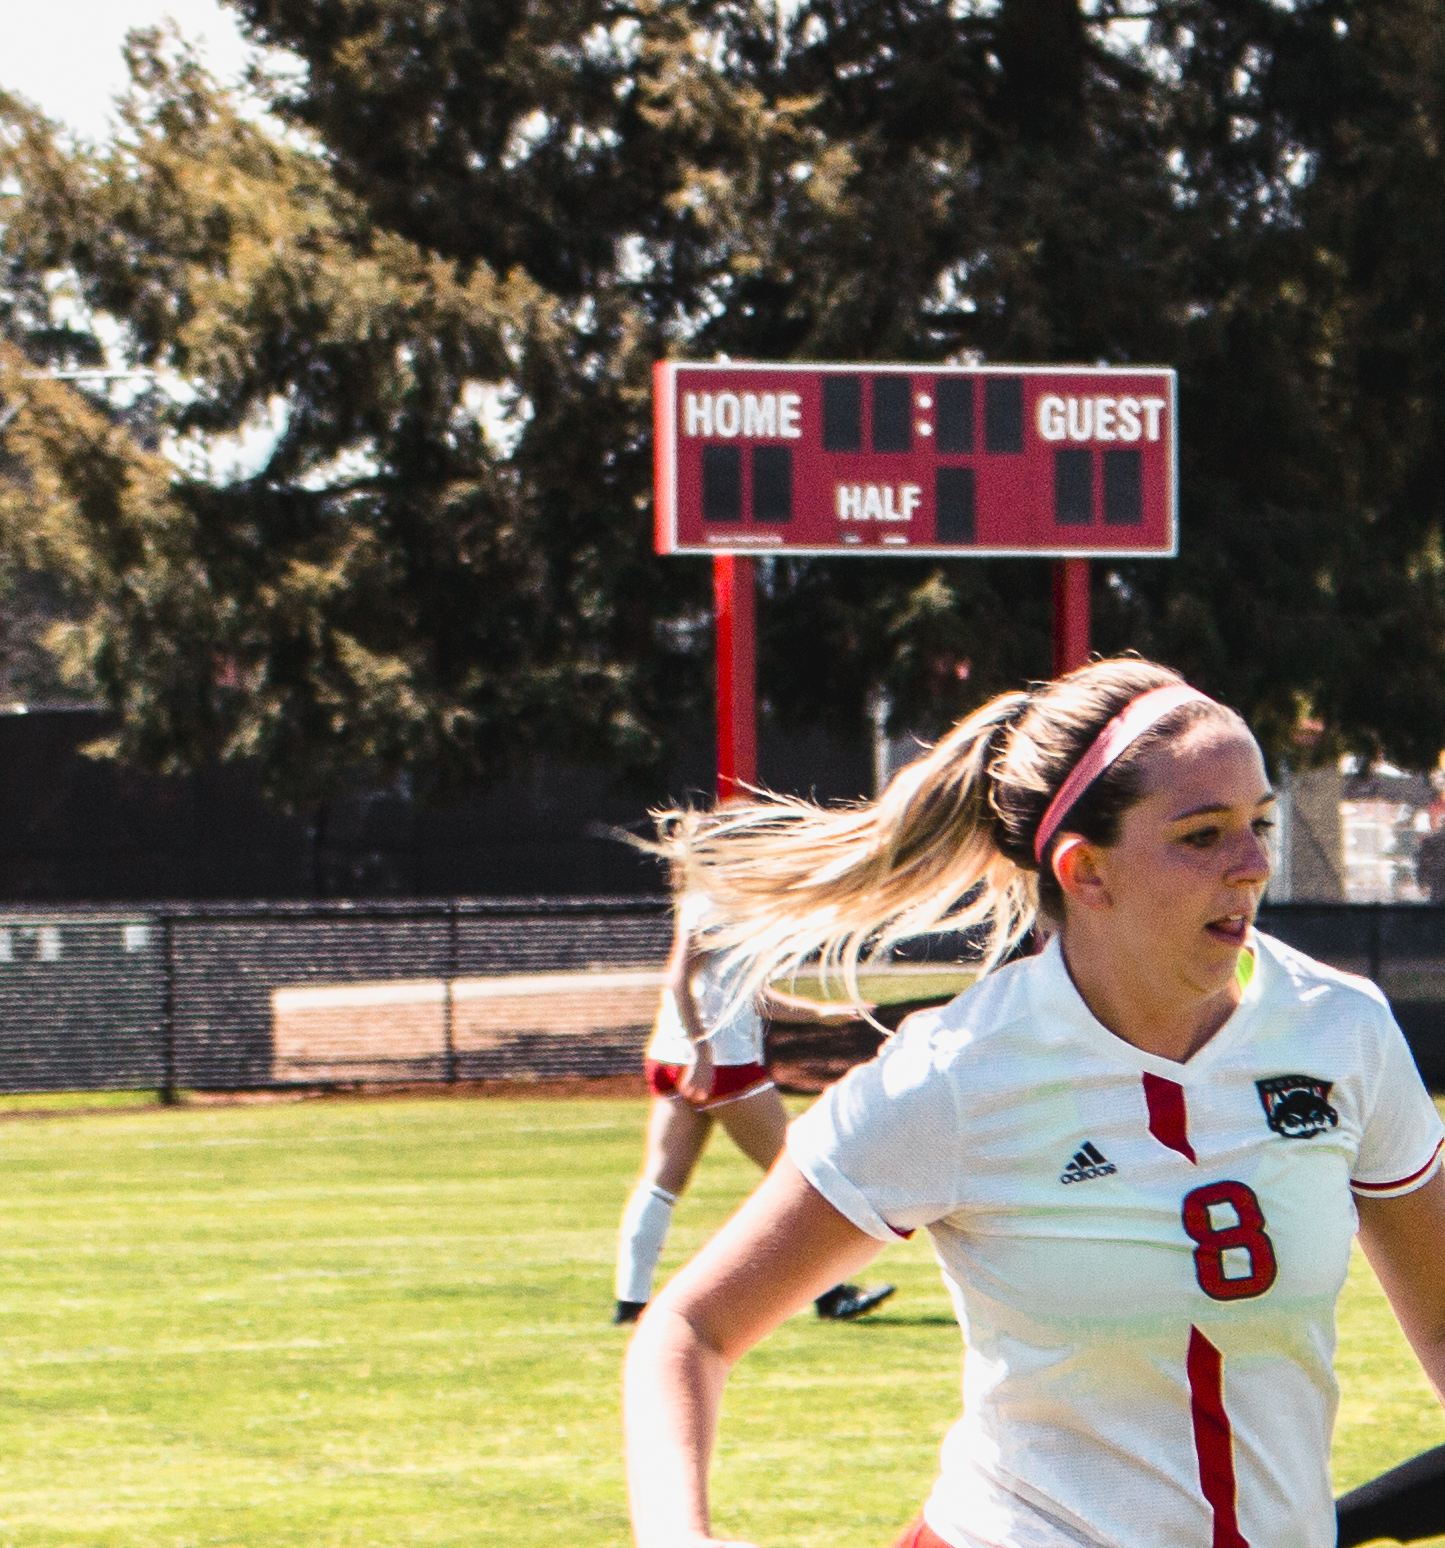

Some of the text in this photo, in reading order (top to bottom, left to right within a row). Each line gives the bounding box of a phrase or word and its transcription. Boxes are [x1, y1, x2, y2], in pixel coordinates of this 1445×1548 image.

[684, 393, 802, 438] HOME
[1038, 395, 1165, 441] GUEST
[837, 486, 922, 520] HALF
[1061, 1164, 1117, 1184] adidas
[1182, 1180, 1277, 1301] 8
